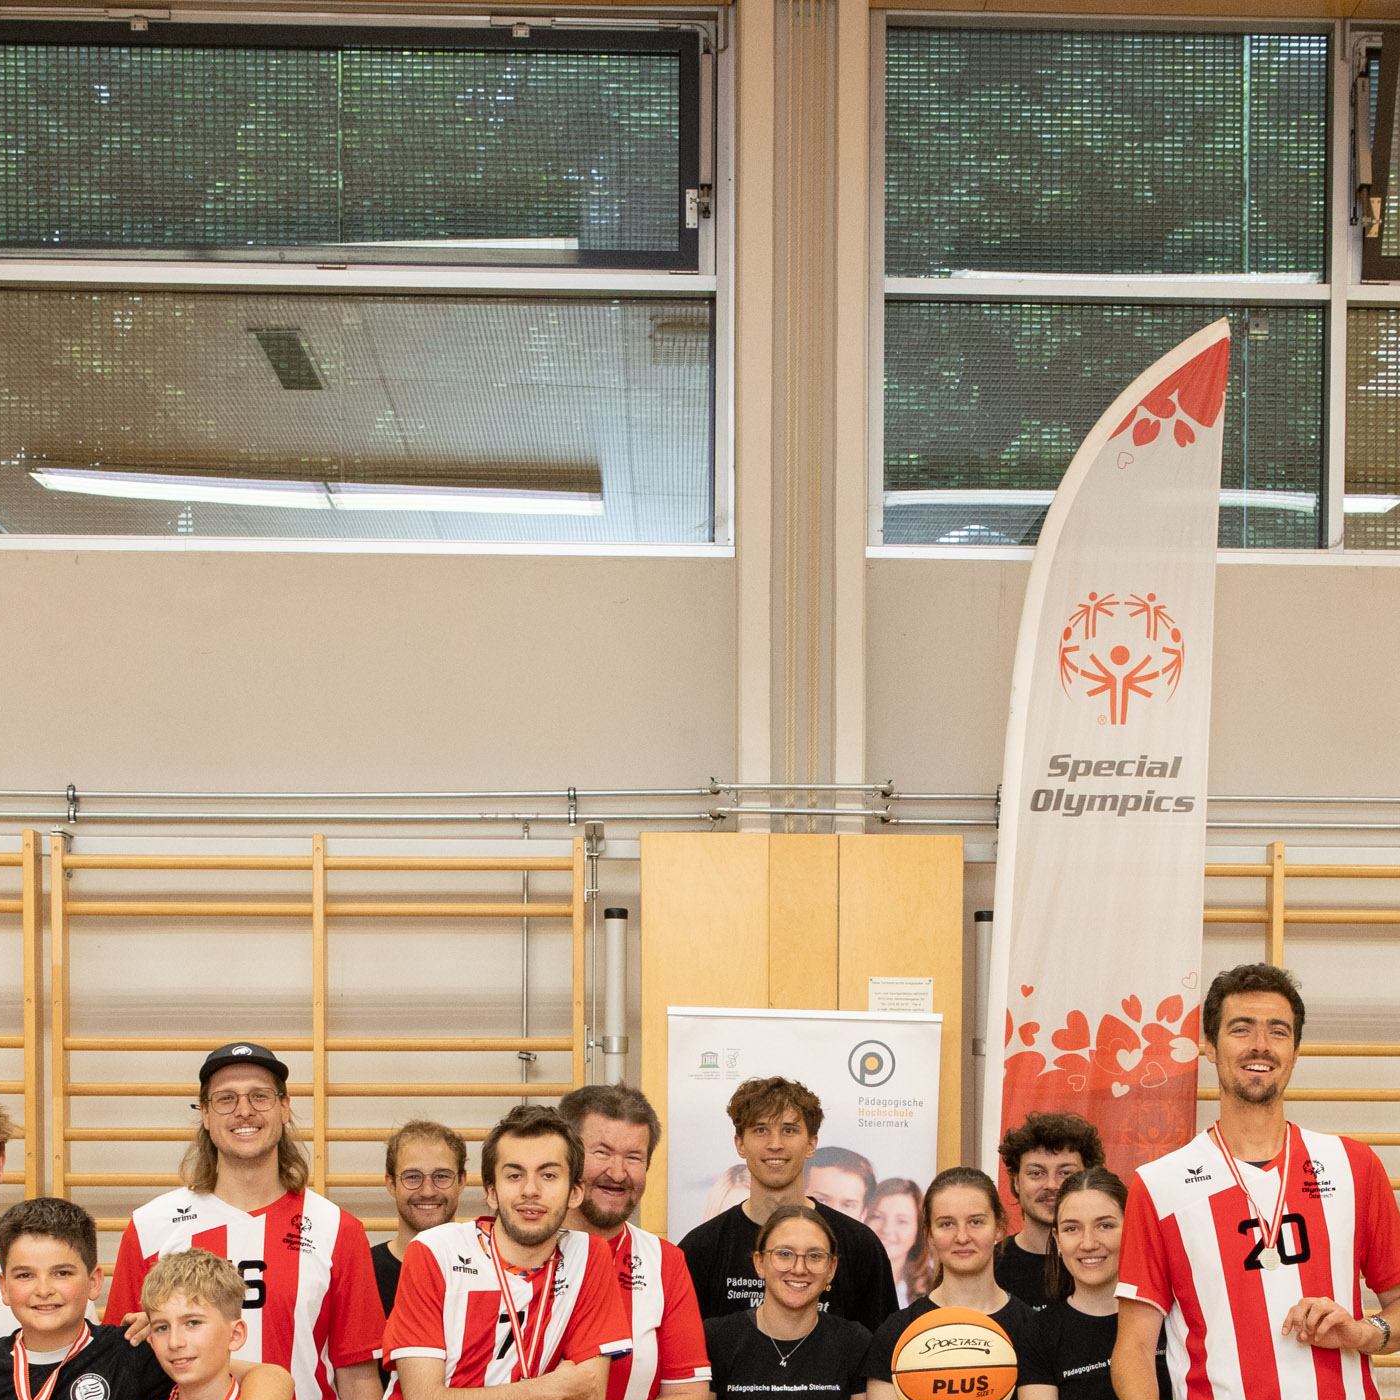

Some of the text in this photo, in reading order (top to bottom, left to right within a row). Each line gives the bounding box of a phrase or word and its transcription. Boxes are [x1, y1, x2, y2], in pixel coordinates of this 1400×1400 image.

[1047, 754, 1183, 781] Special
[1030, 788, 1195, 818] Olympics
[858, 1096, 925, 1108] Pädagogische
[858, 1108, 914, 1118] Hochschule
[858, 1118, 910, 1128] Steiermark
[1184, 1174, 1212, 1184] erima
[1301, 1186, 1337, 1194] Olympics
[172, 1213, 198, 1223] erima
[1237, 1213, 1311, 1271] 20
[452, 1264, 479, 1275] erima
[229, 1260, 268, 1310] 6
[726, 1277, 766, 1288] Pädagogi
[727, 1290, 764, 1300] Steierma
[496, 1311, 526, 1361] 7
[919, 1337, 994, 1355] SPORTASTIC
[1063, 1361, 1107, 1378] Pädagogische
[727, 1383, 841, 1393] Pädagogische Hochschule Steiermark
[932, 1375, 989, 1394] PLUS
[976, 1389, 989, 1398] SIZE
